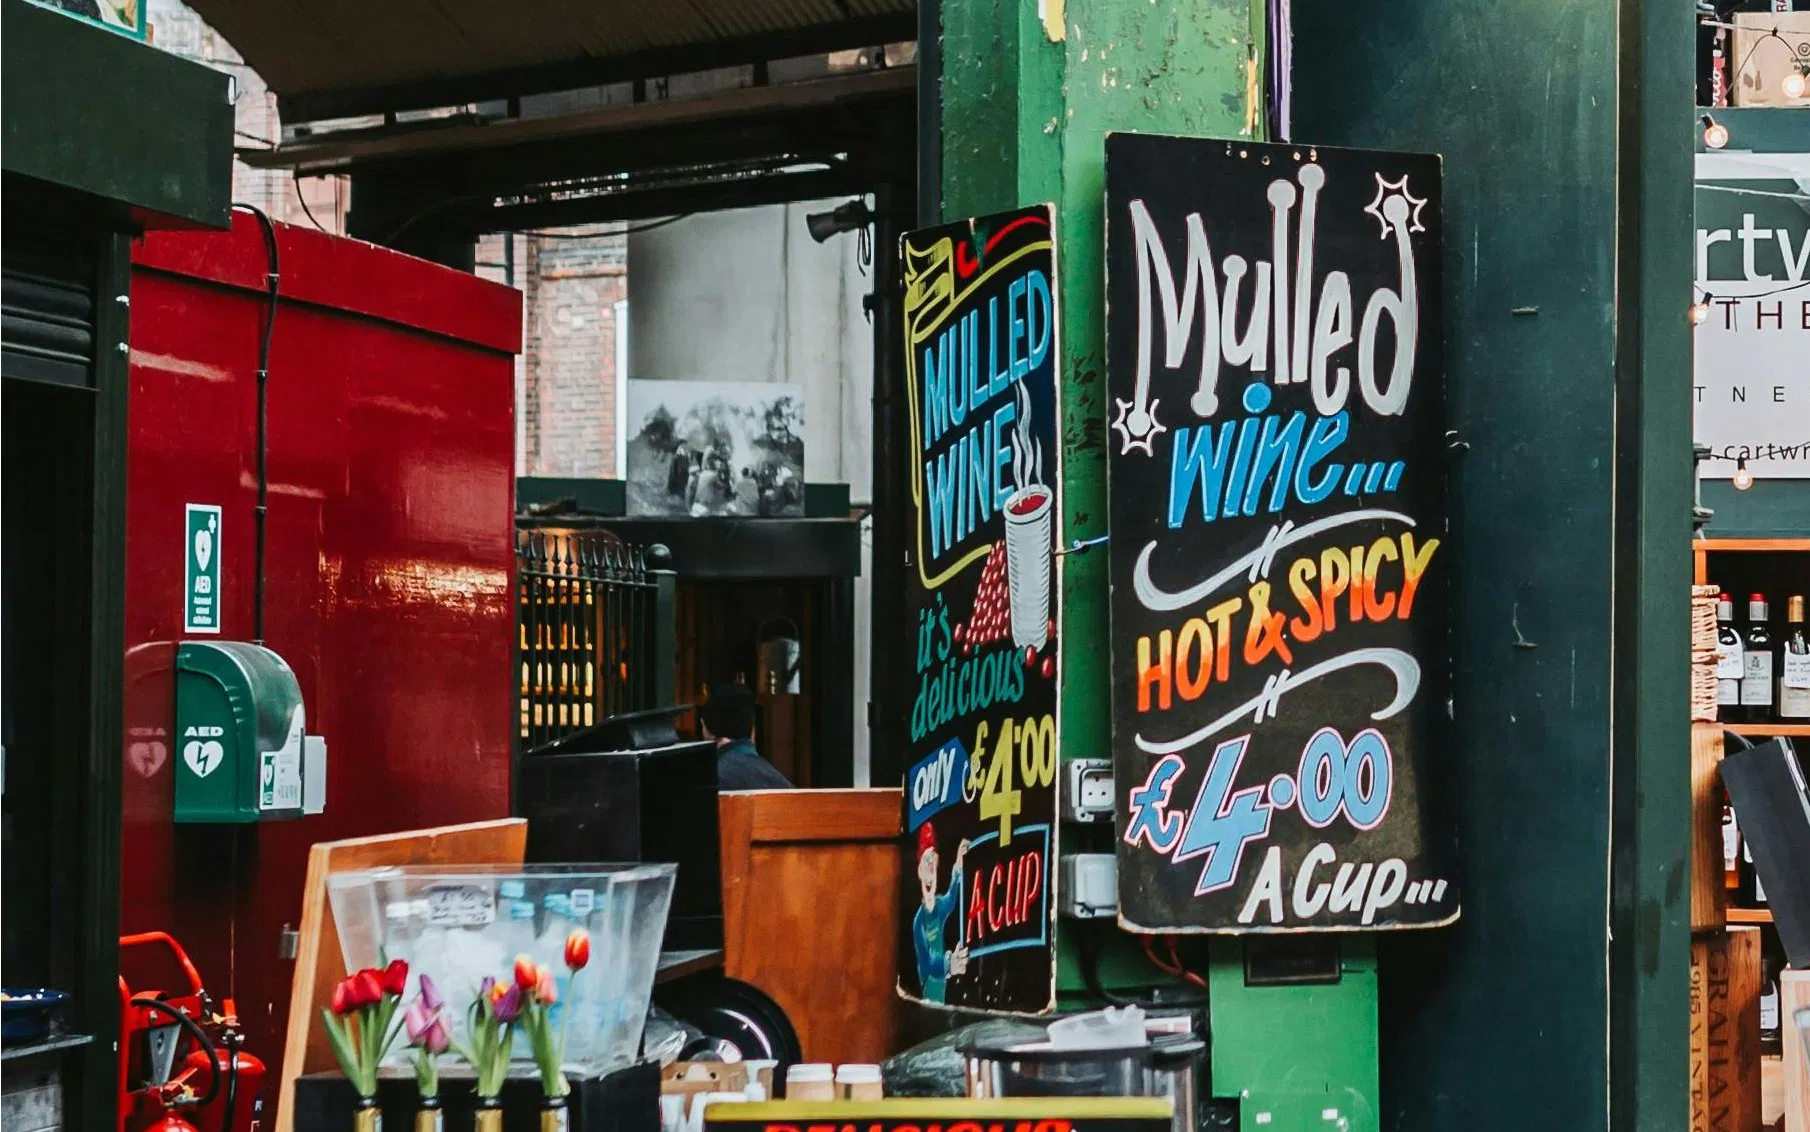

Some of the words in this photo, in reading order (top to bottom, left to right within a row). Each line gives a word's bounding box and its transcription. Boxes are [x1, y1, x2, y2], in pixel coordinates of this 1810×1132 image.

[1124, 164, 1420, 416] Mulled
[922, 269, 1052, 451] MULLED
[926, 408, 1015, 562] WINE
[916, 591, 952, 671] it's
[184, 726, 224, 737] AED
[910, 645, 1027, 744] delicious
[912, 757, 959, 813] only
[968, 875, 990, 941] A
[990, 851, 1043, 931] CUP
[1238, 865, 1284, 924] A
